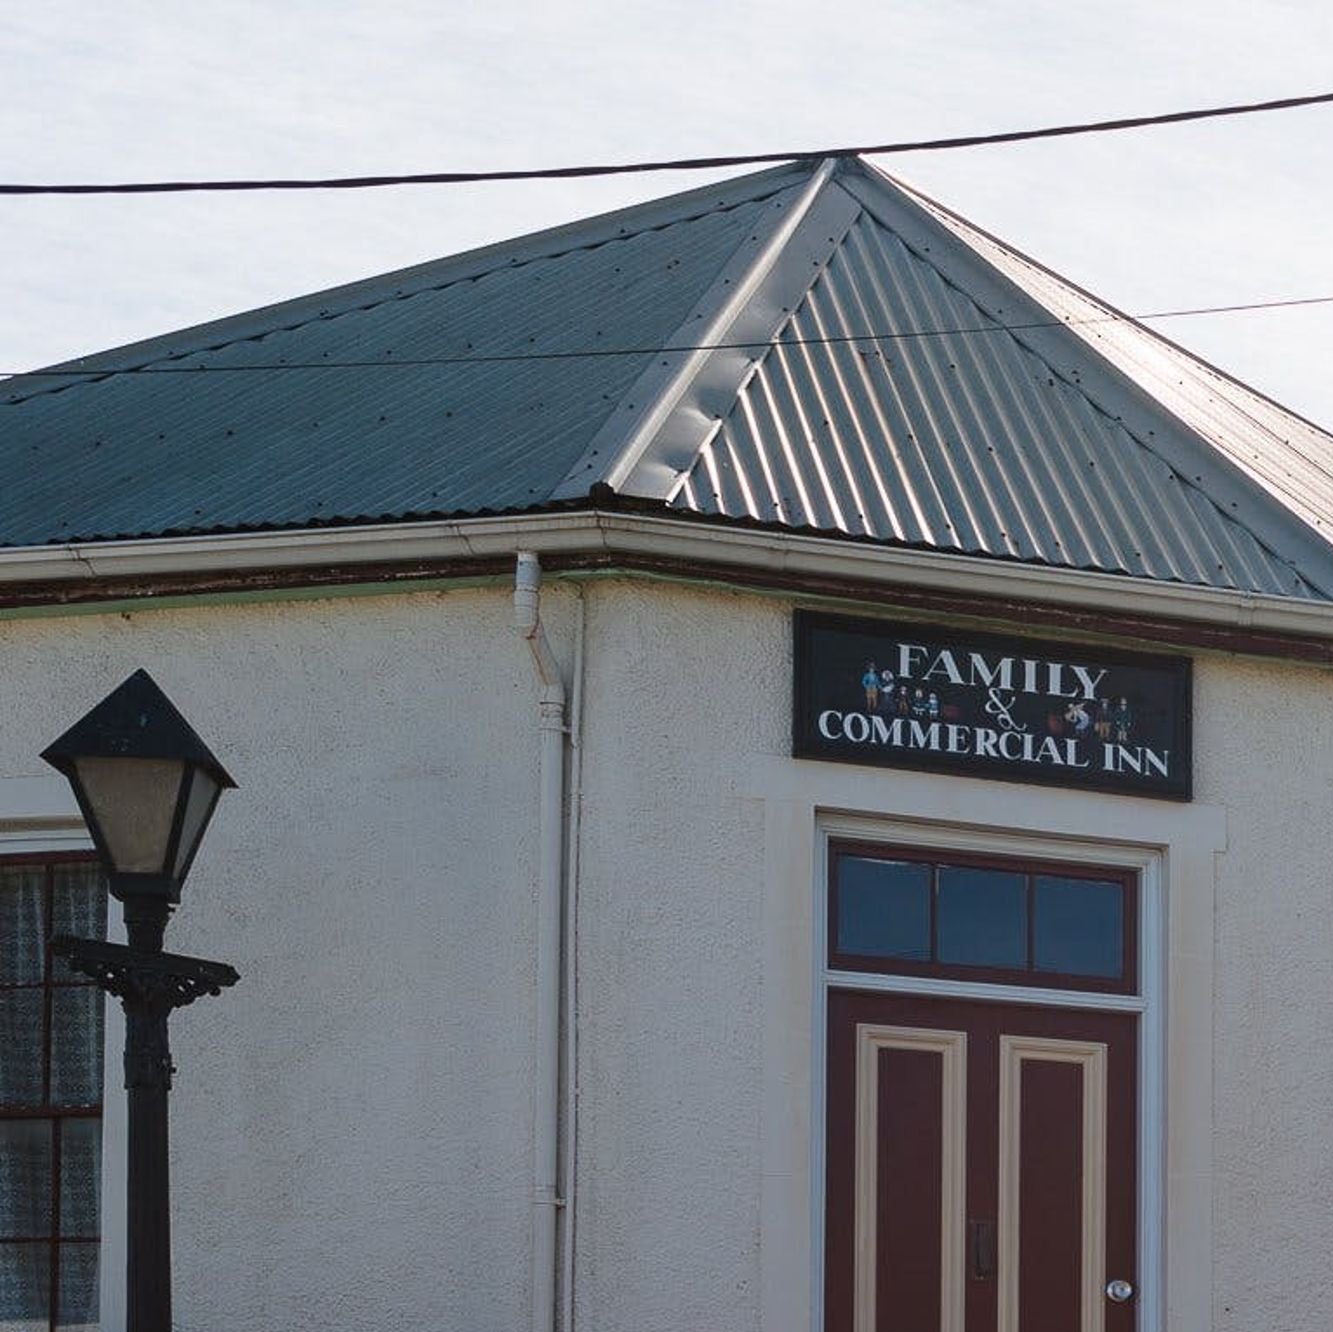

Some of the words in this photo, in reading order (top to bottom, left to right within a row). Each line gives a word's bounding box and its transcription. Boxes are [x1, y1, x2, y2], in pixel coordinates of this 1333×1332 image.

[897, 643, 1109, 700] FAMILY
[984, 687, 1027, 731] &
[818, 710, 1090, 768] COMMERCIAL
[1102, 744, 1170, 778] INN
